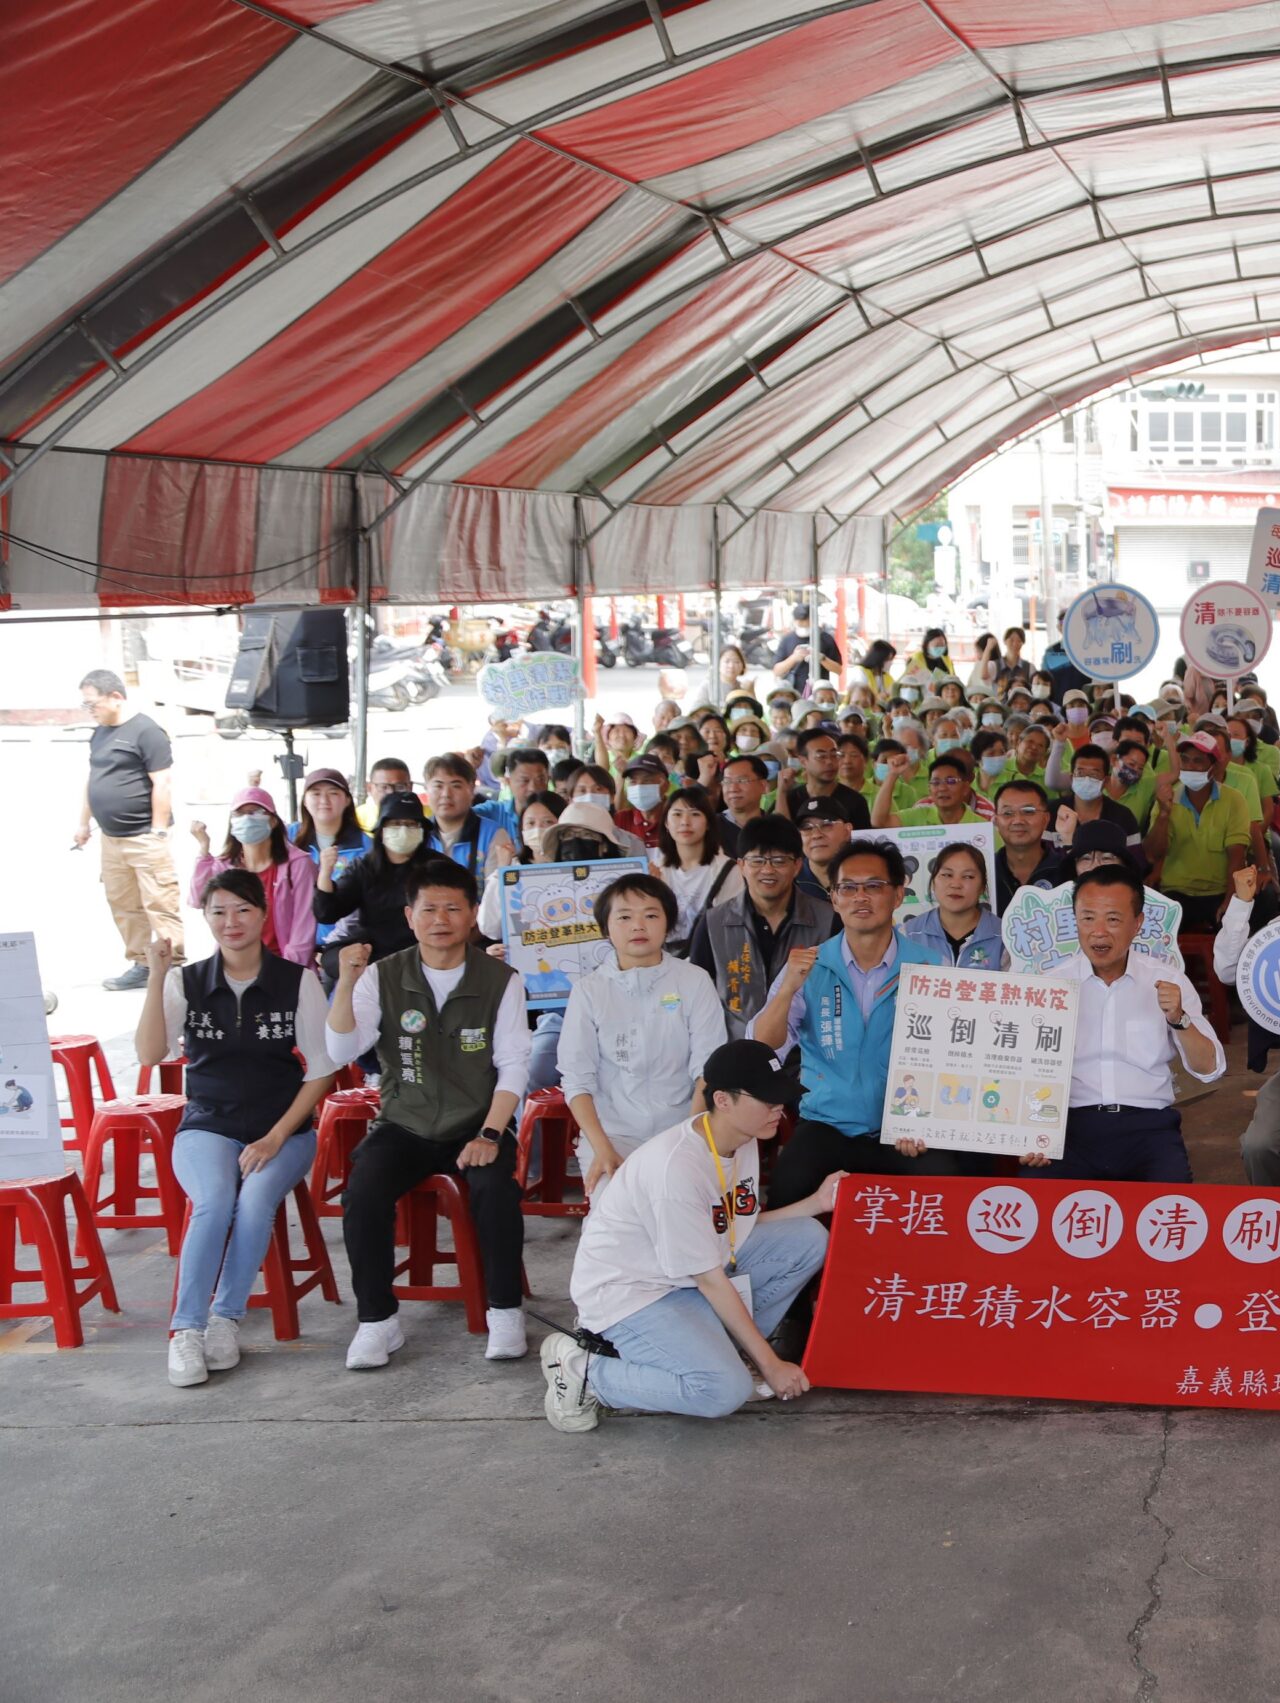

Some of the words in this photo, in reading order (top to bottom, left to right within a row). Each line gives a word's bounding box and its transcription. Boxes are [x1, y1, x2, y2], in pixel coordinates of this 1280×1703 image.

[524, 923, 600, 943] 防治登革熱大
[909, 975, 1069, 1011] 防治登革熱秘笈
[906, 1013, 933, 1041] 巡
[950, 1017, 976, 1045] 倒
[993, 1021, 1019, 1049] 清
[1035, 1026, 1062, 1053] 刷
[854, 1185, 949, 1236] 掌握
[975, 1199, 1026, 1242] 巡
[1059, 1201, 1111, 1249] 倒
[1149, 1203, 1197, 1251] 清
